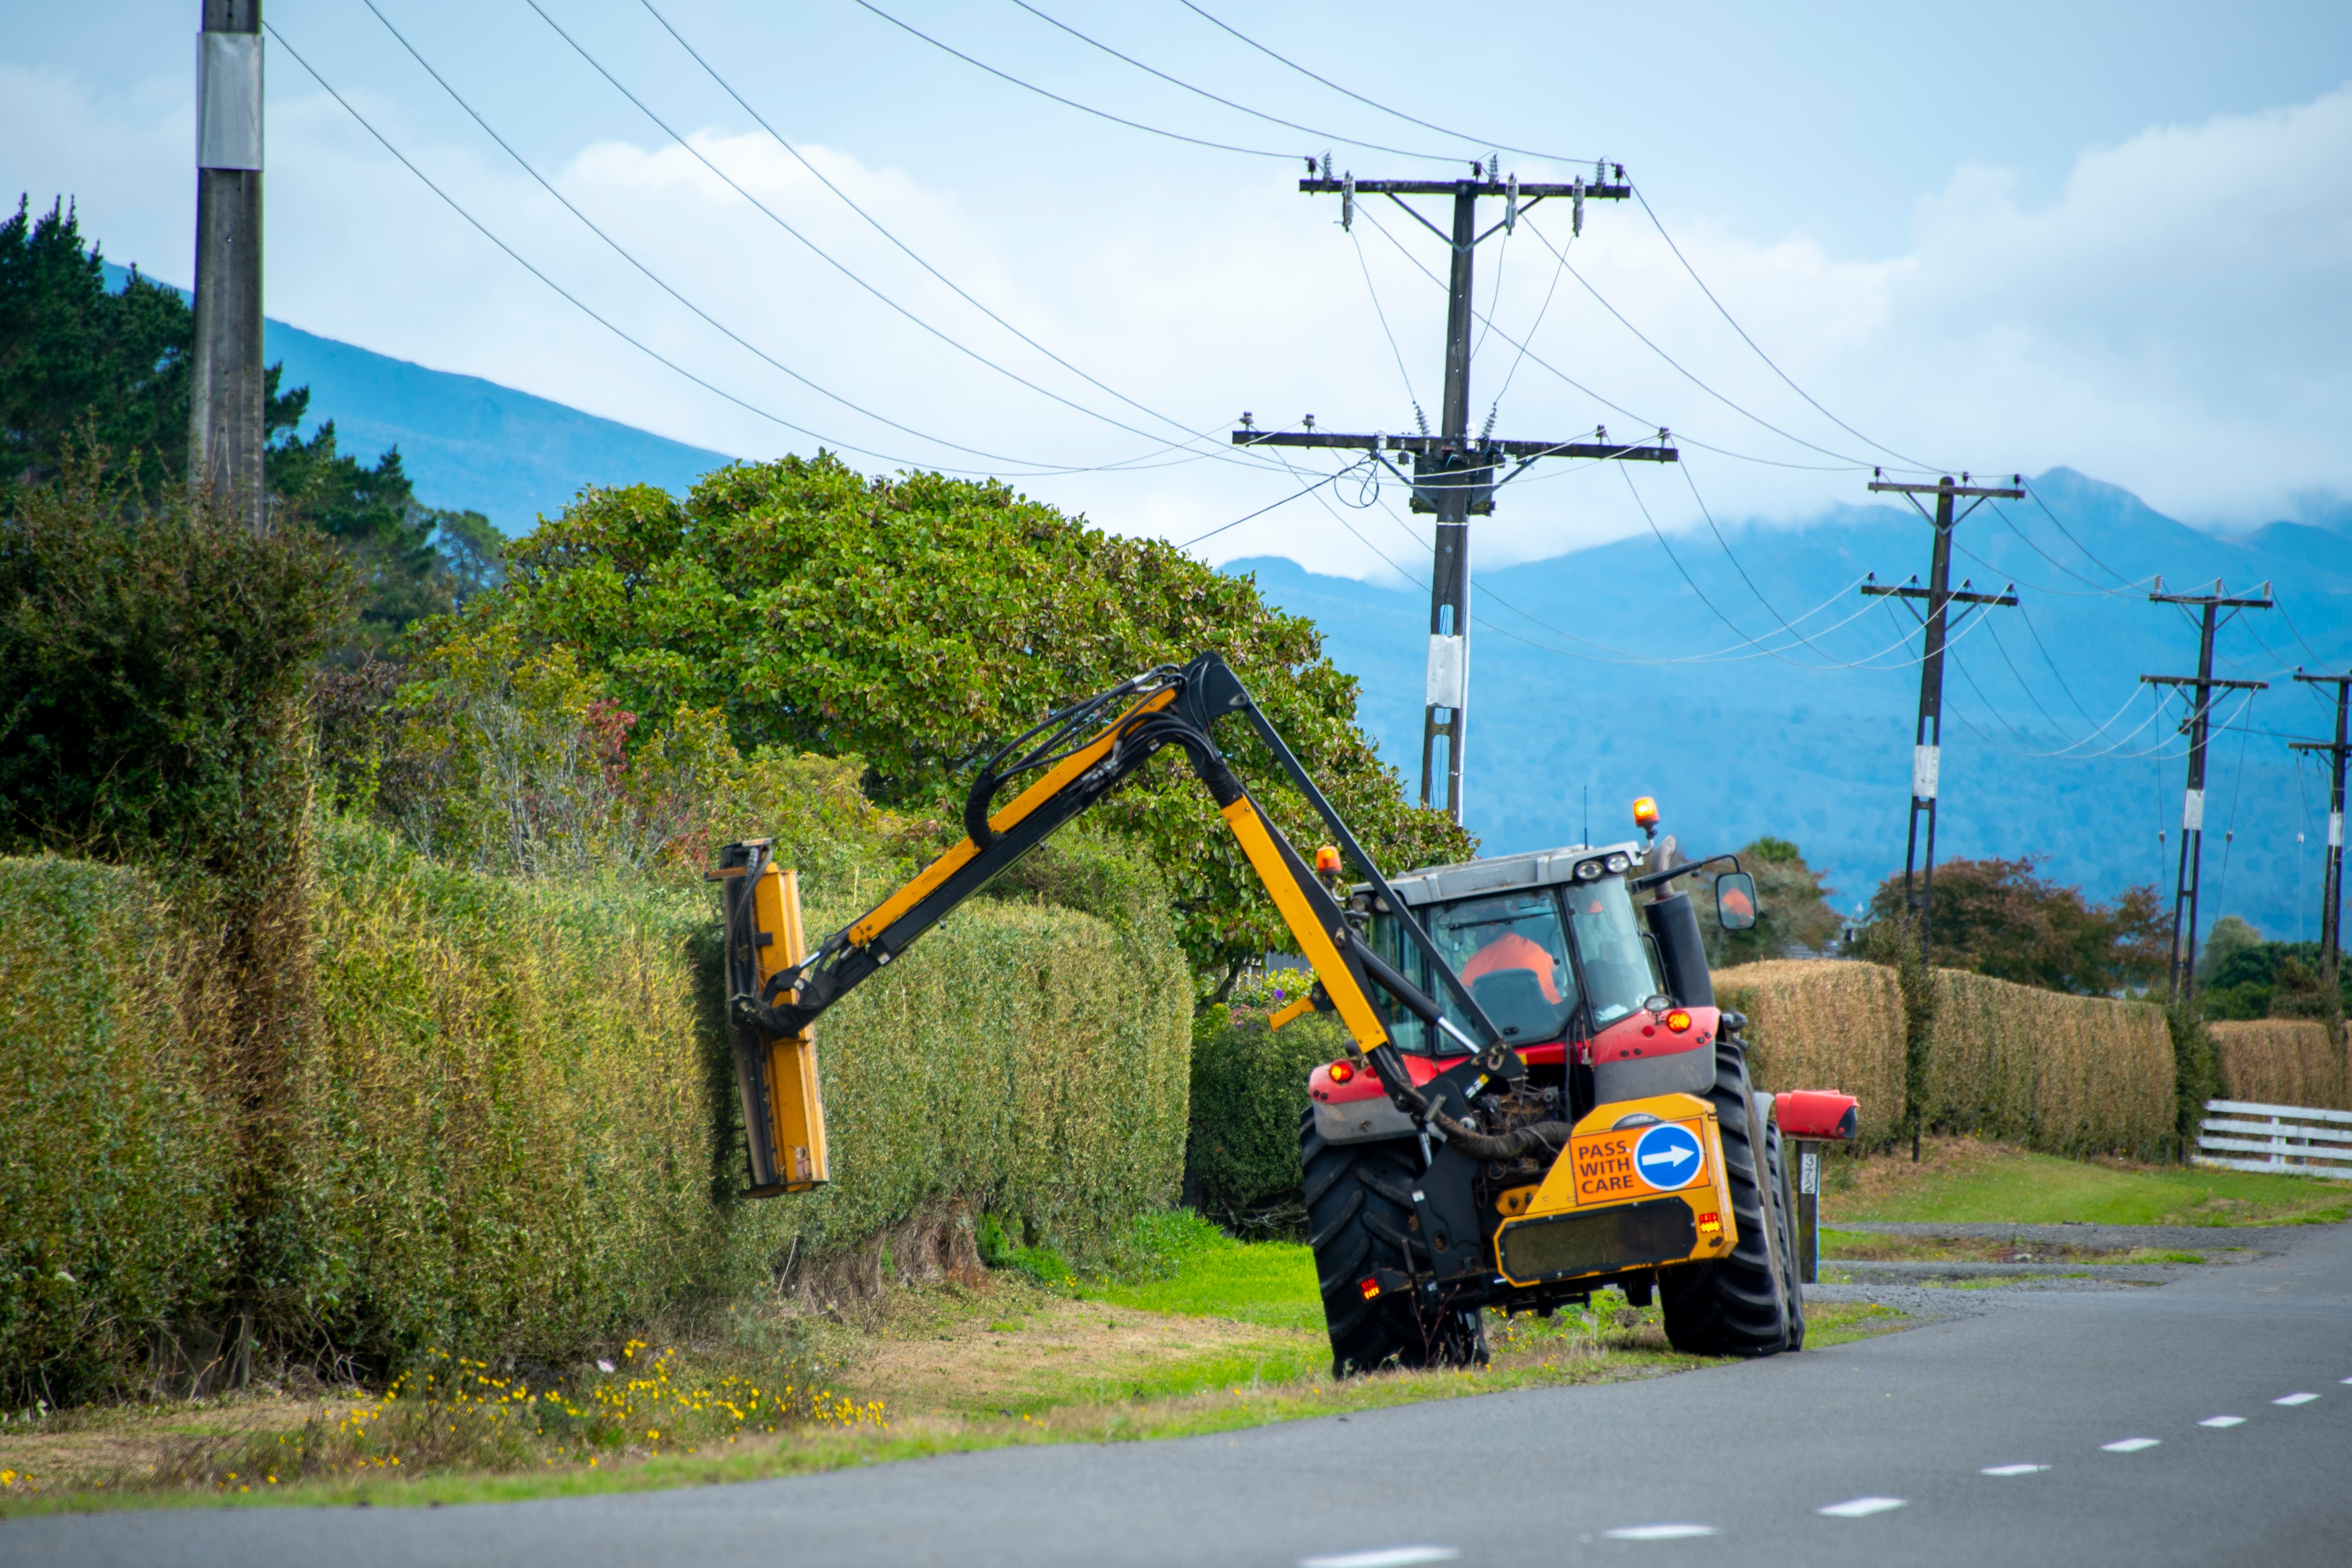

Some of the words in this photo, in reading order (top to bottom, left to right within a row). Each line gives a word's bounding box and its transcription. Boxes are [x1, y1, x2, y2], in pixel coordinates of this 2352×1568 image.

[1579, 1140, 1627, 1160] PASS
[1579, 1157, 1630, 1177] WITH
[1805, 1155, 1814, 1192] 372
[1582, 1175, 1634, 1193] CARE
